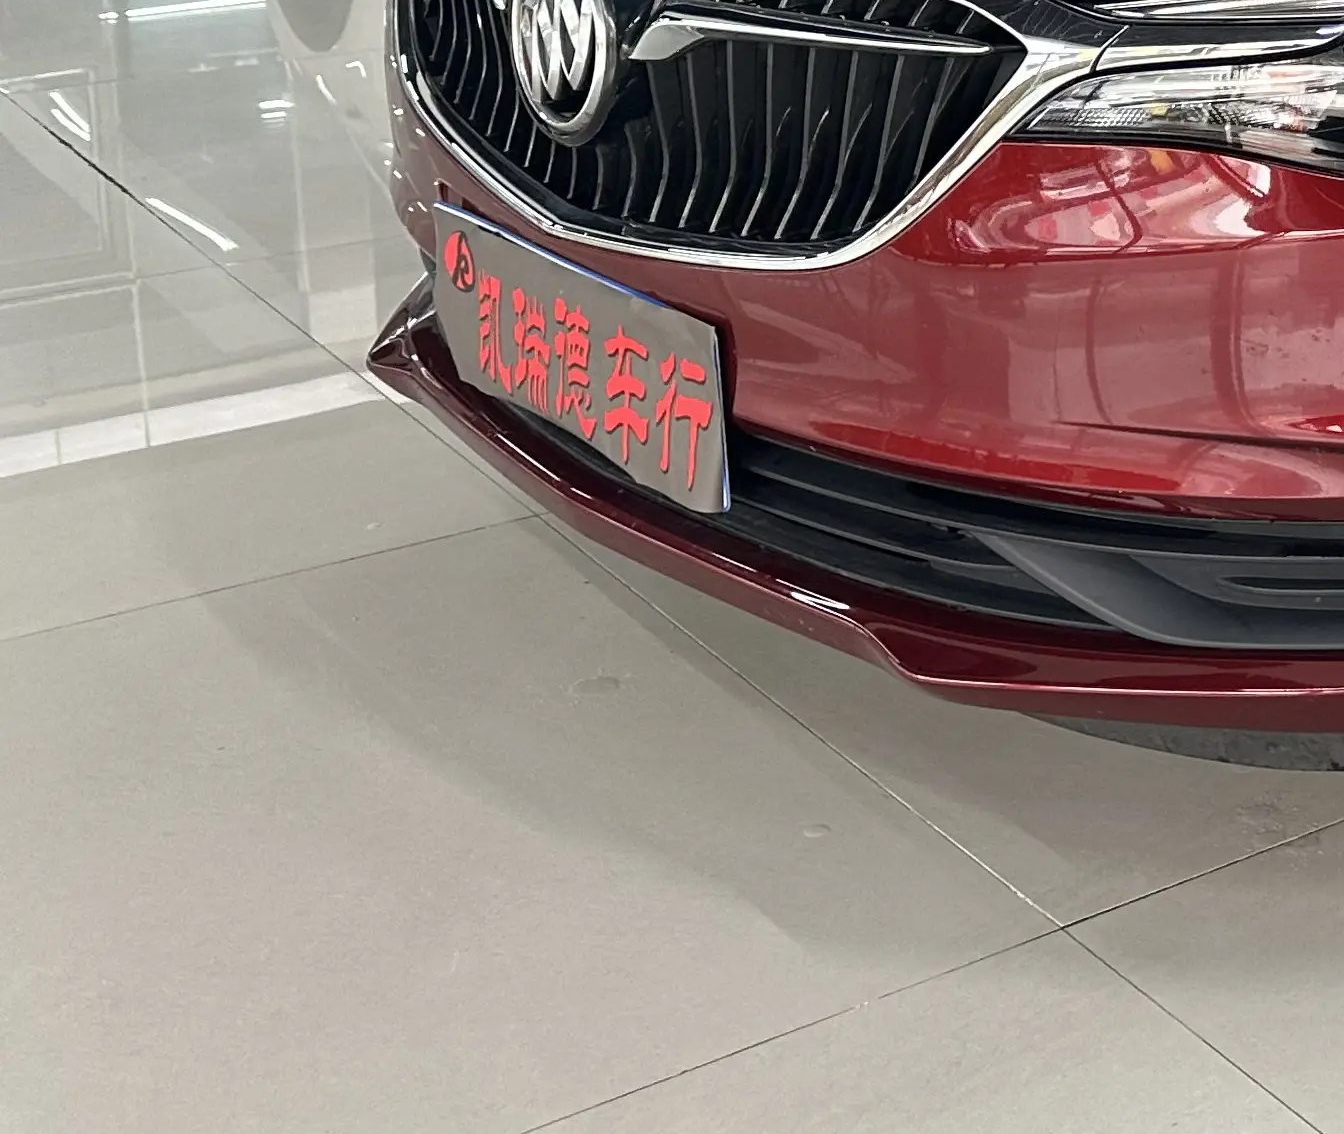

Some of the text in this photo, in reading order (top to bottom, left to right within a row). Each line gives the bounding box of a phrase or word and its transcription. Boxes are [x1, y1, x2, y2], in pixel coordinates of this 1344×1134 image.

[479, 268, 713, 491] 凯瑞德车行
